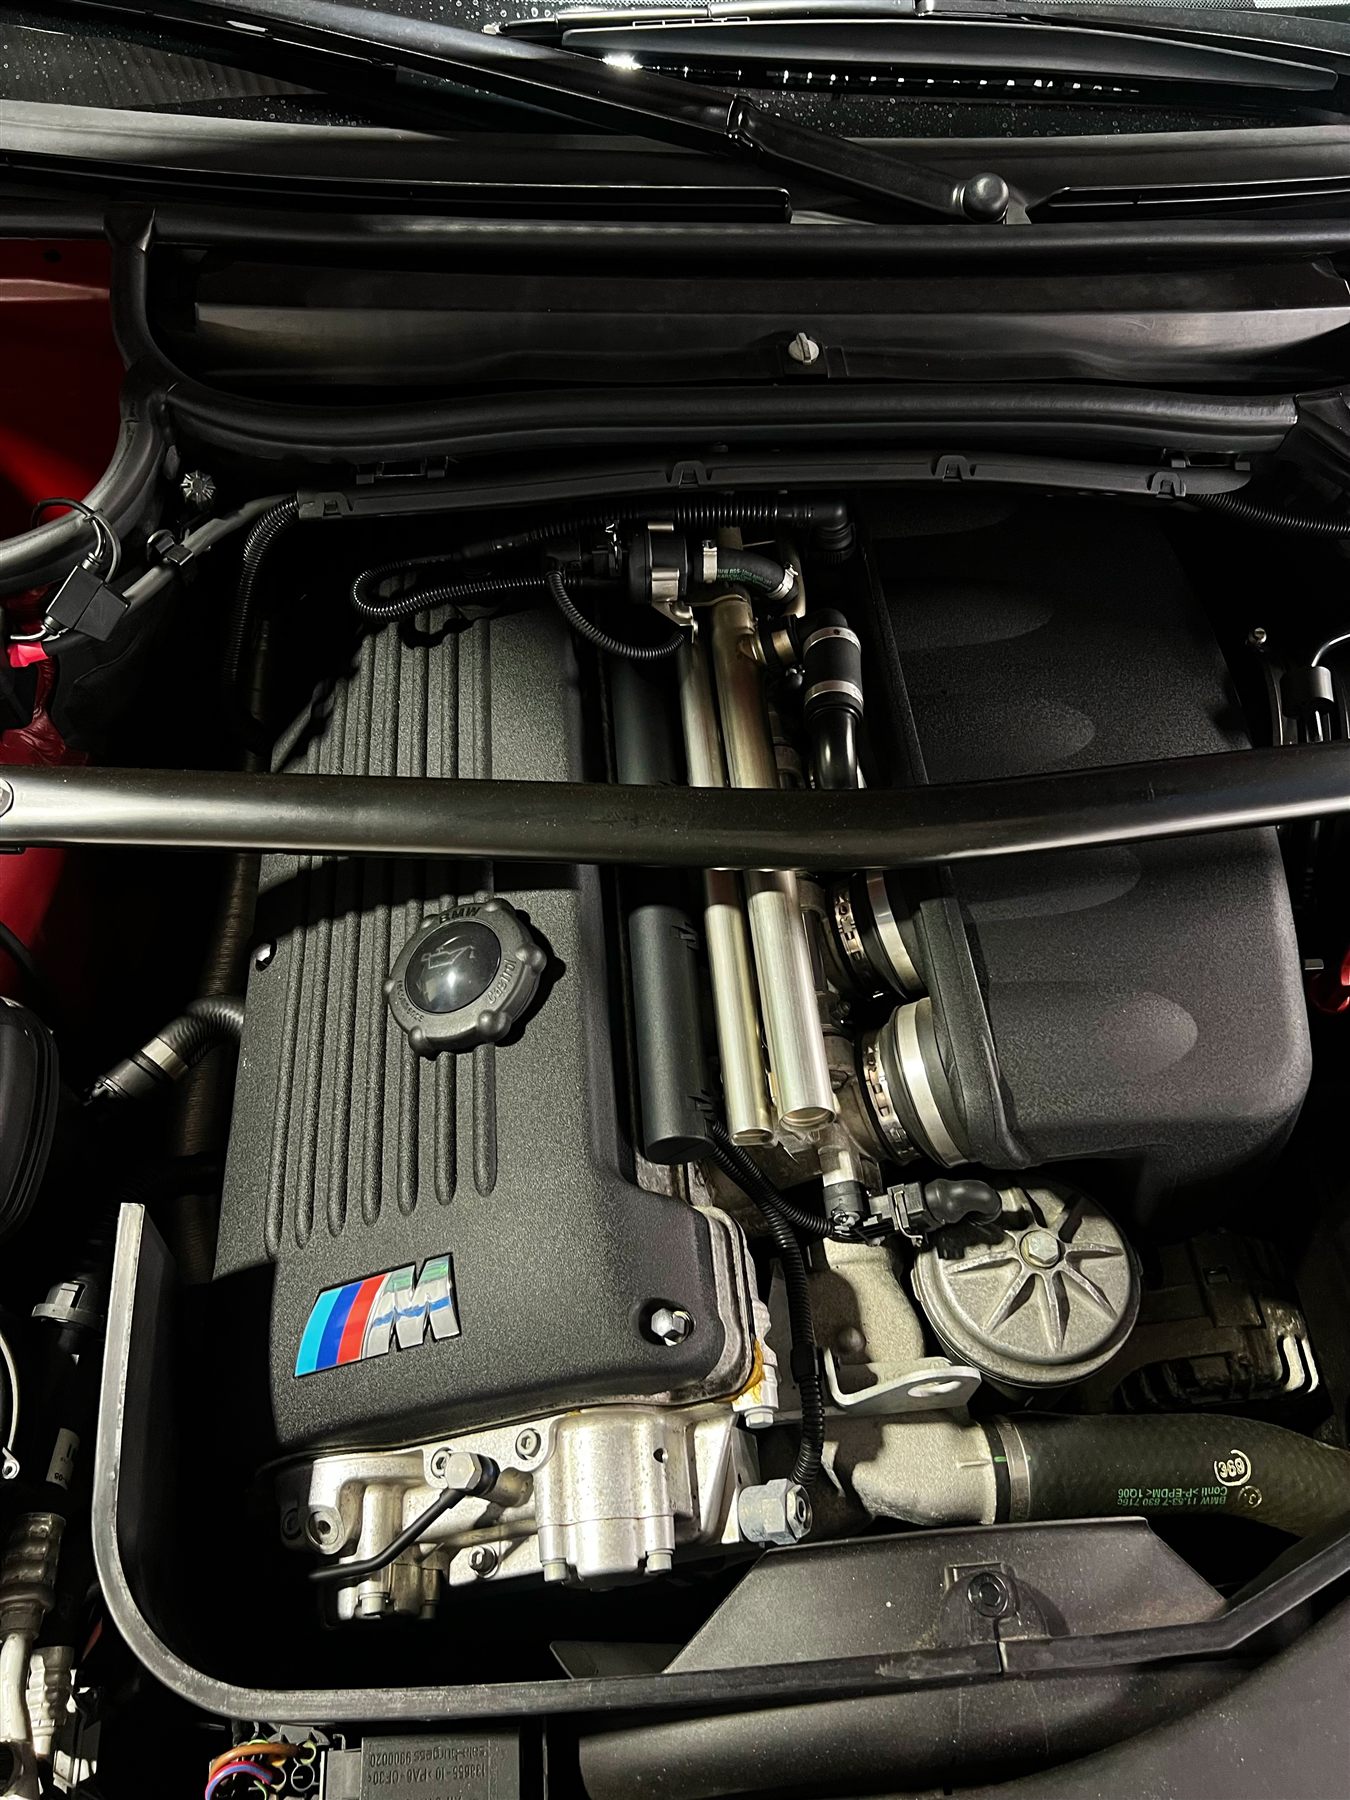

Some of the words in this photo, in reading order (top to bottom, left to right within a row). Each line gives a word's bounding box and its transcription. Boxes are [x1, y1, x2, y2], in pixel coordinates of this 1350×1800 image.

[439, 906, 481, 923] BMW
[487, 957, 517, 1004] Castrol
[362, 1253, 461, 1358] M
[1200, 1496, 1226, 1505] BMW
[1201, 1486, 1228, 1496] Conti
